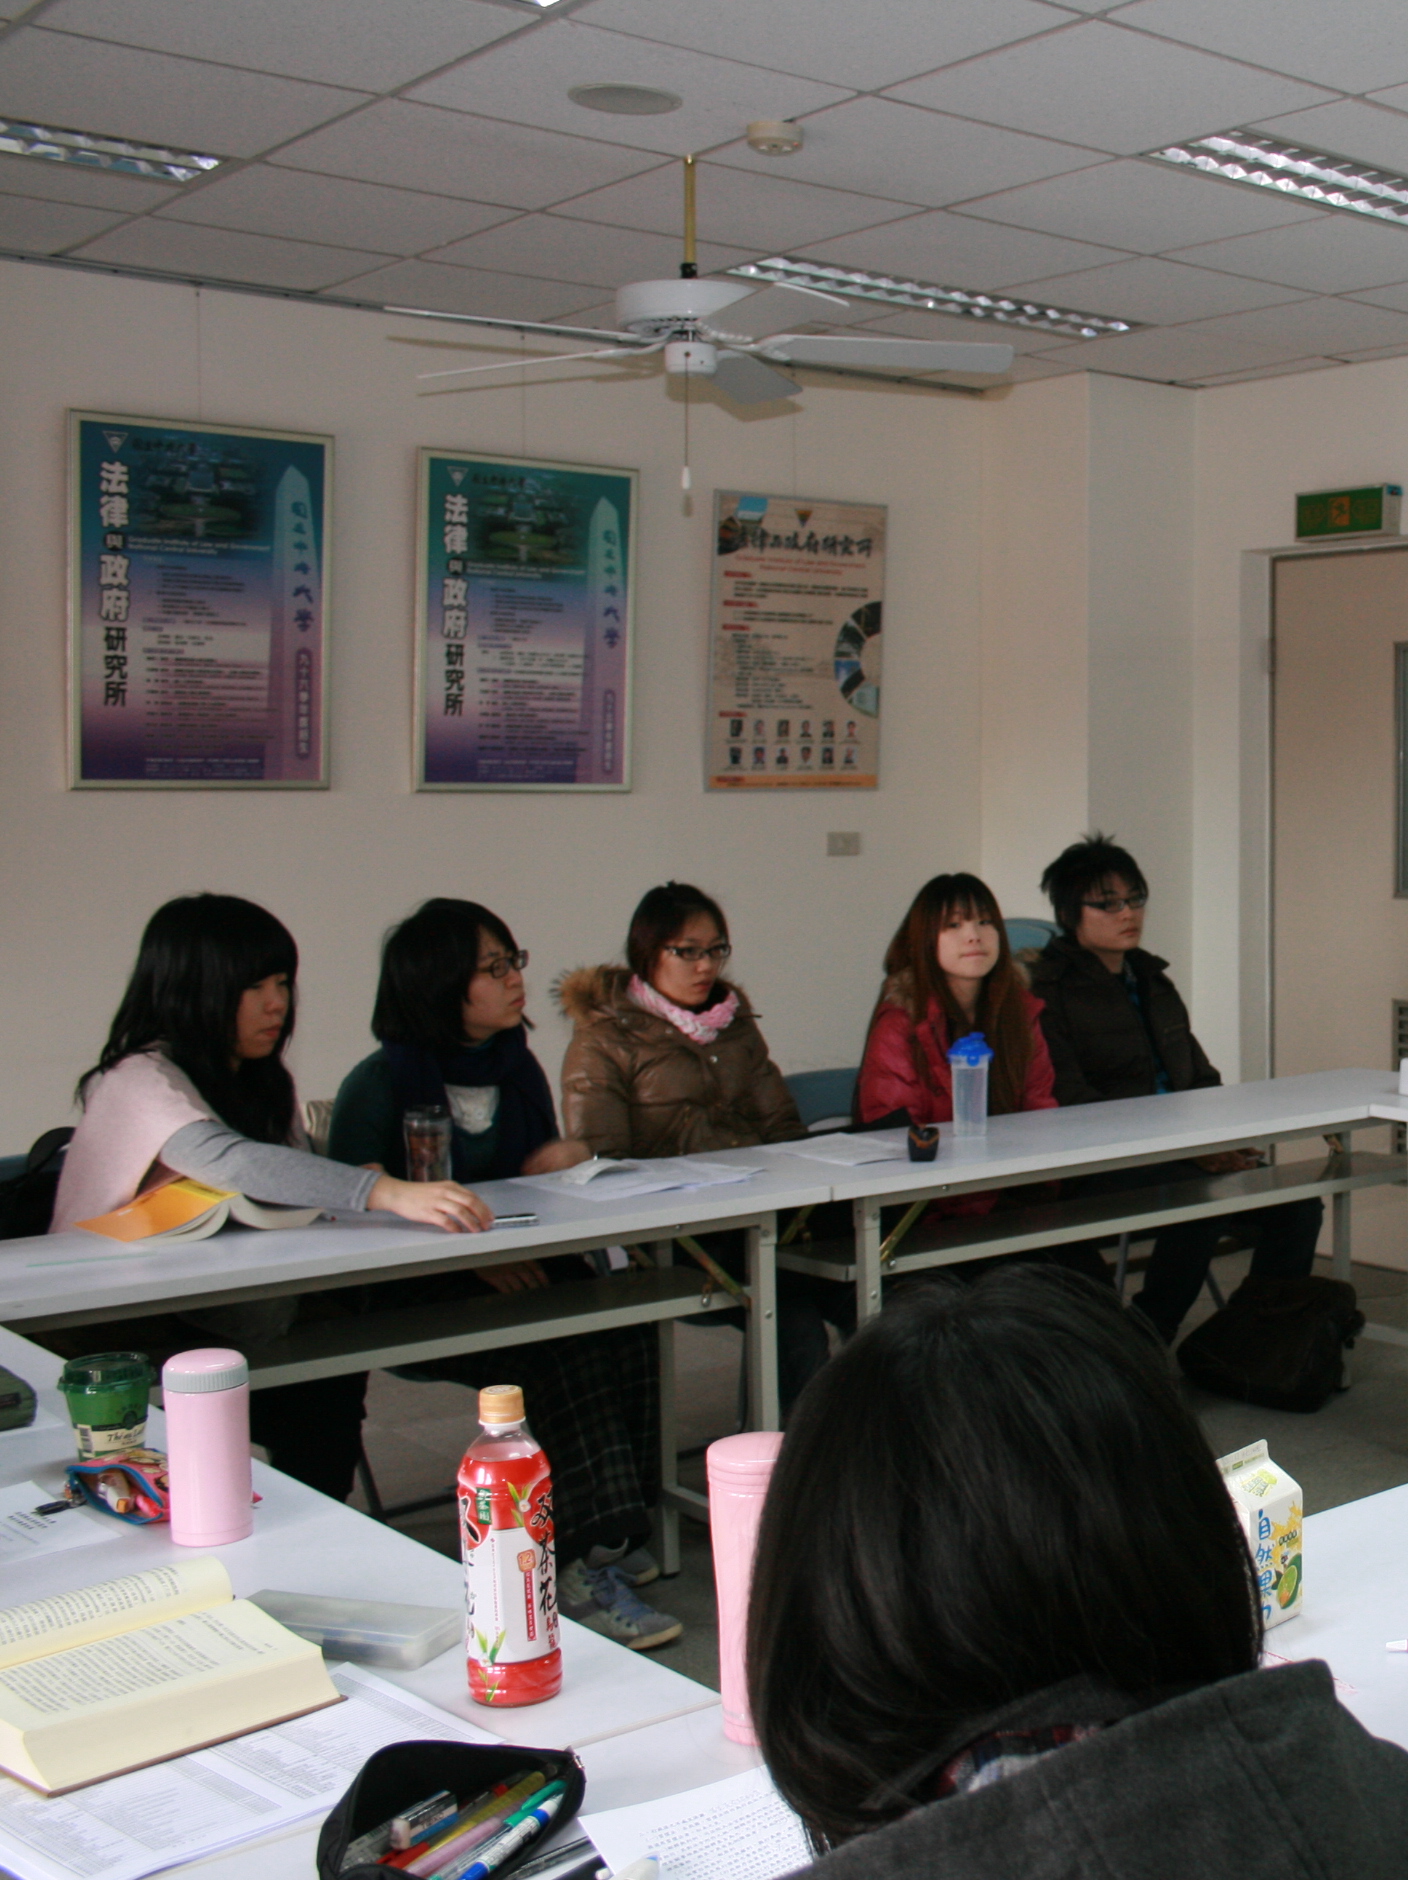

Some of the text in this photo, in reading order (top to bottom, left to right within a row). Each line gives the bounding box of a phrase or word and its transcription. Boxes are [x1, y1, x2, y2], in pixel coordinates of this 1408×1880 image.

[99, 461, 130, 706] 法律與政府研究所
[442, 493, 469, 716] 法律與政府研究所
